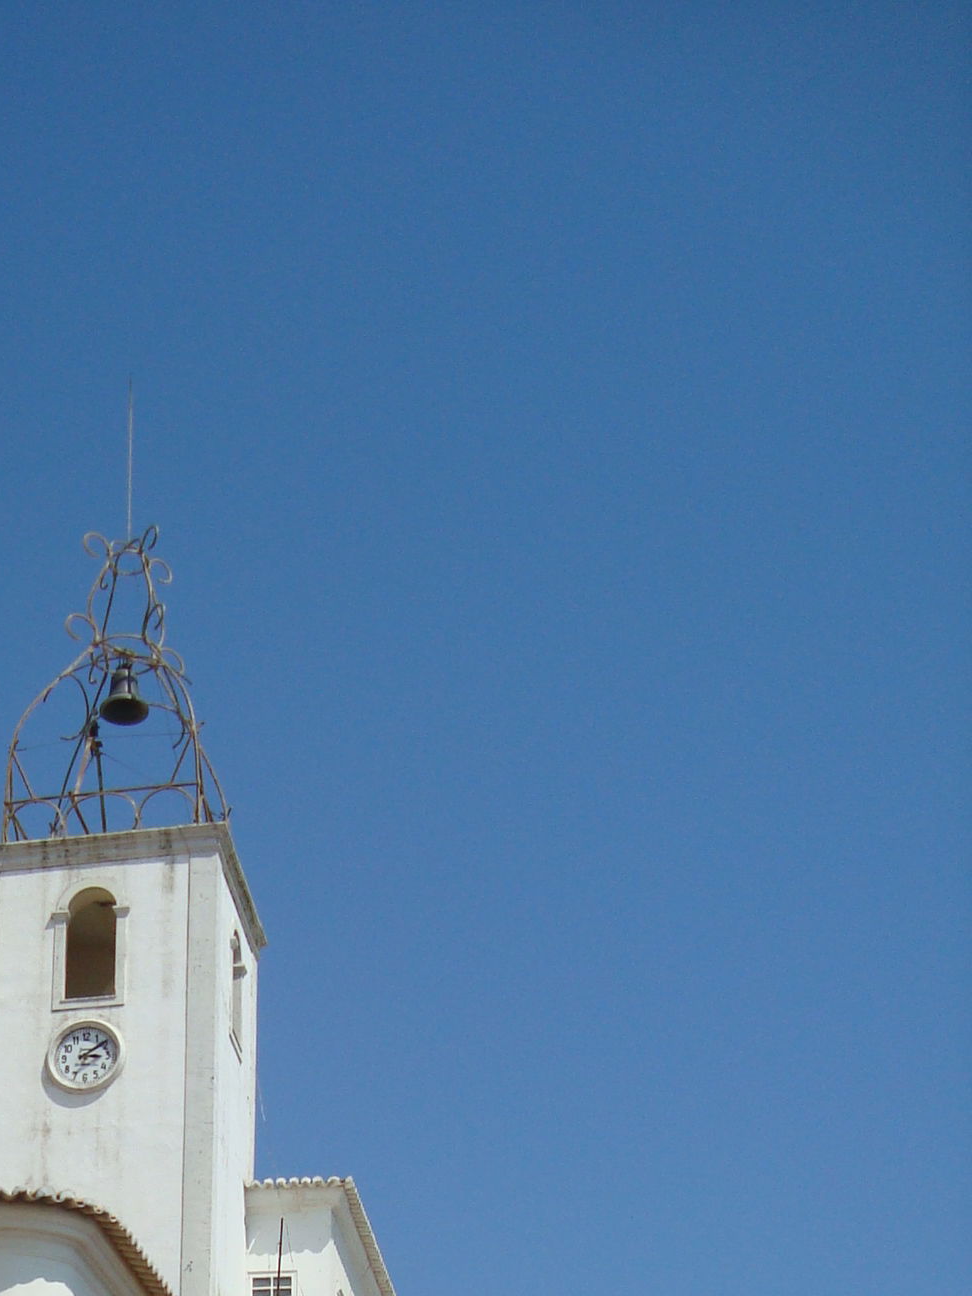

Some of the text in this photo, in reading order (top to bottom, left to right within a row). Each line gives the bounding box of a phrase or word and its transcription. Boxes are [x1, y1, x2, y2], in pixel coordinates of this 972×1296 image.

[72, 1036, 79, 1045] 11
[83, 1032, 91, 1041] 12
[64, 1044, 73, 1053] 10
